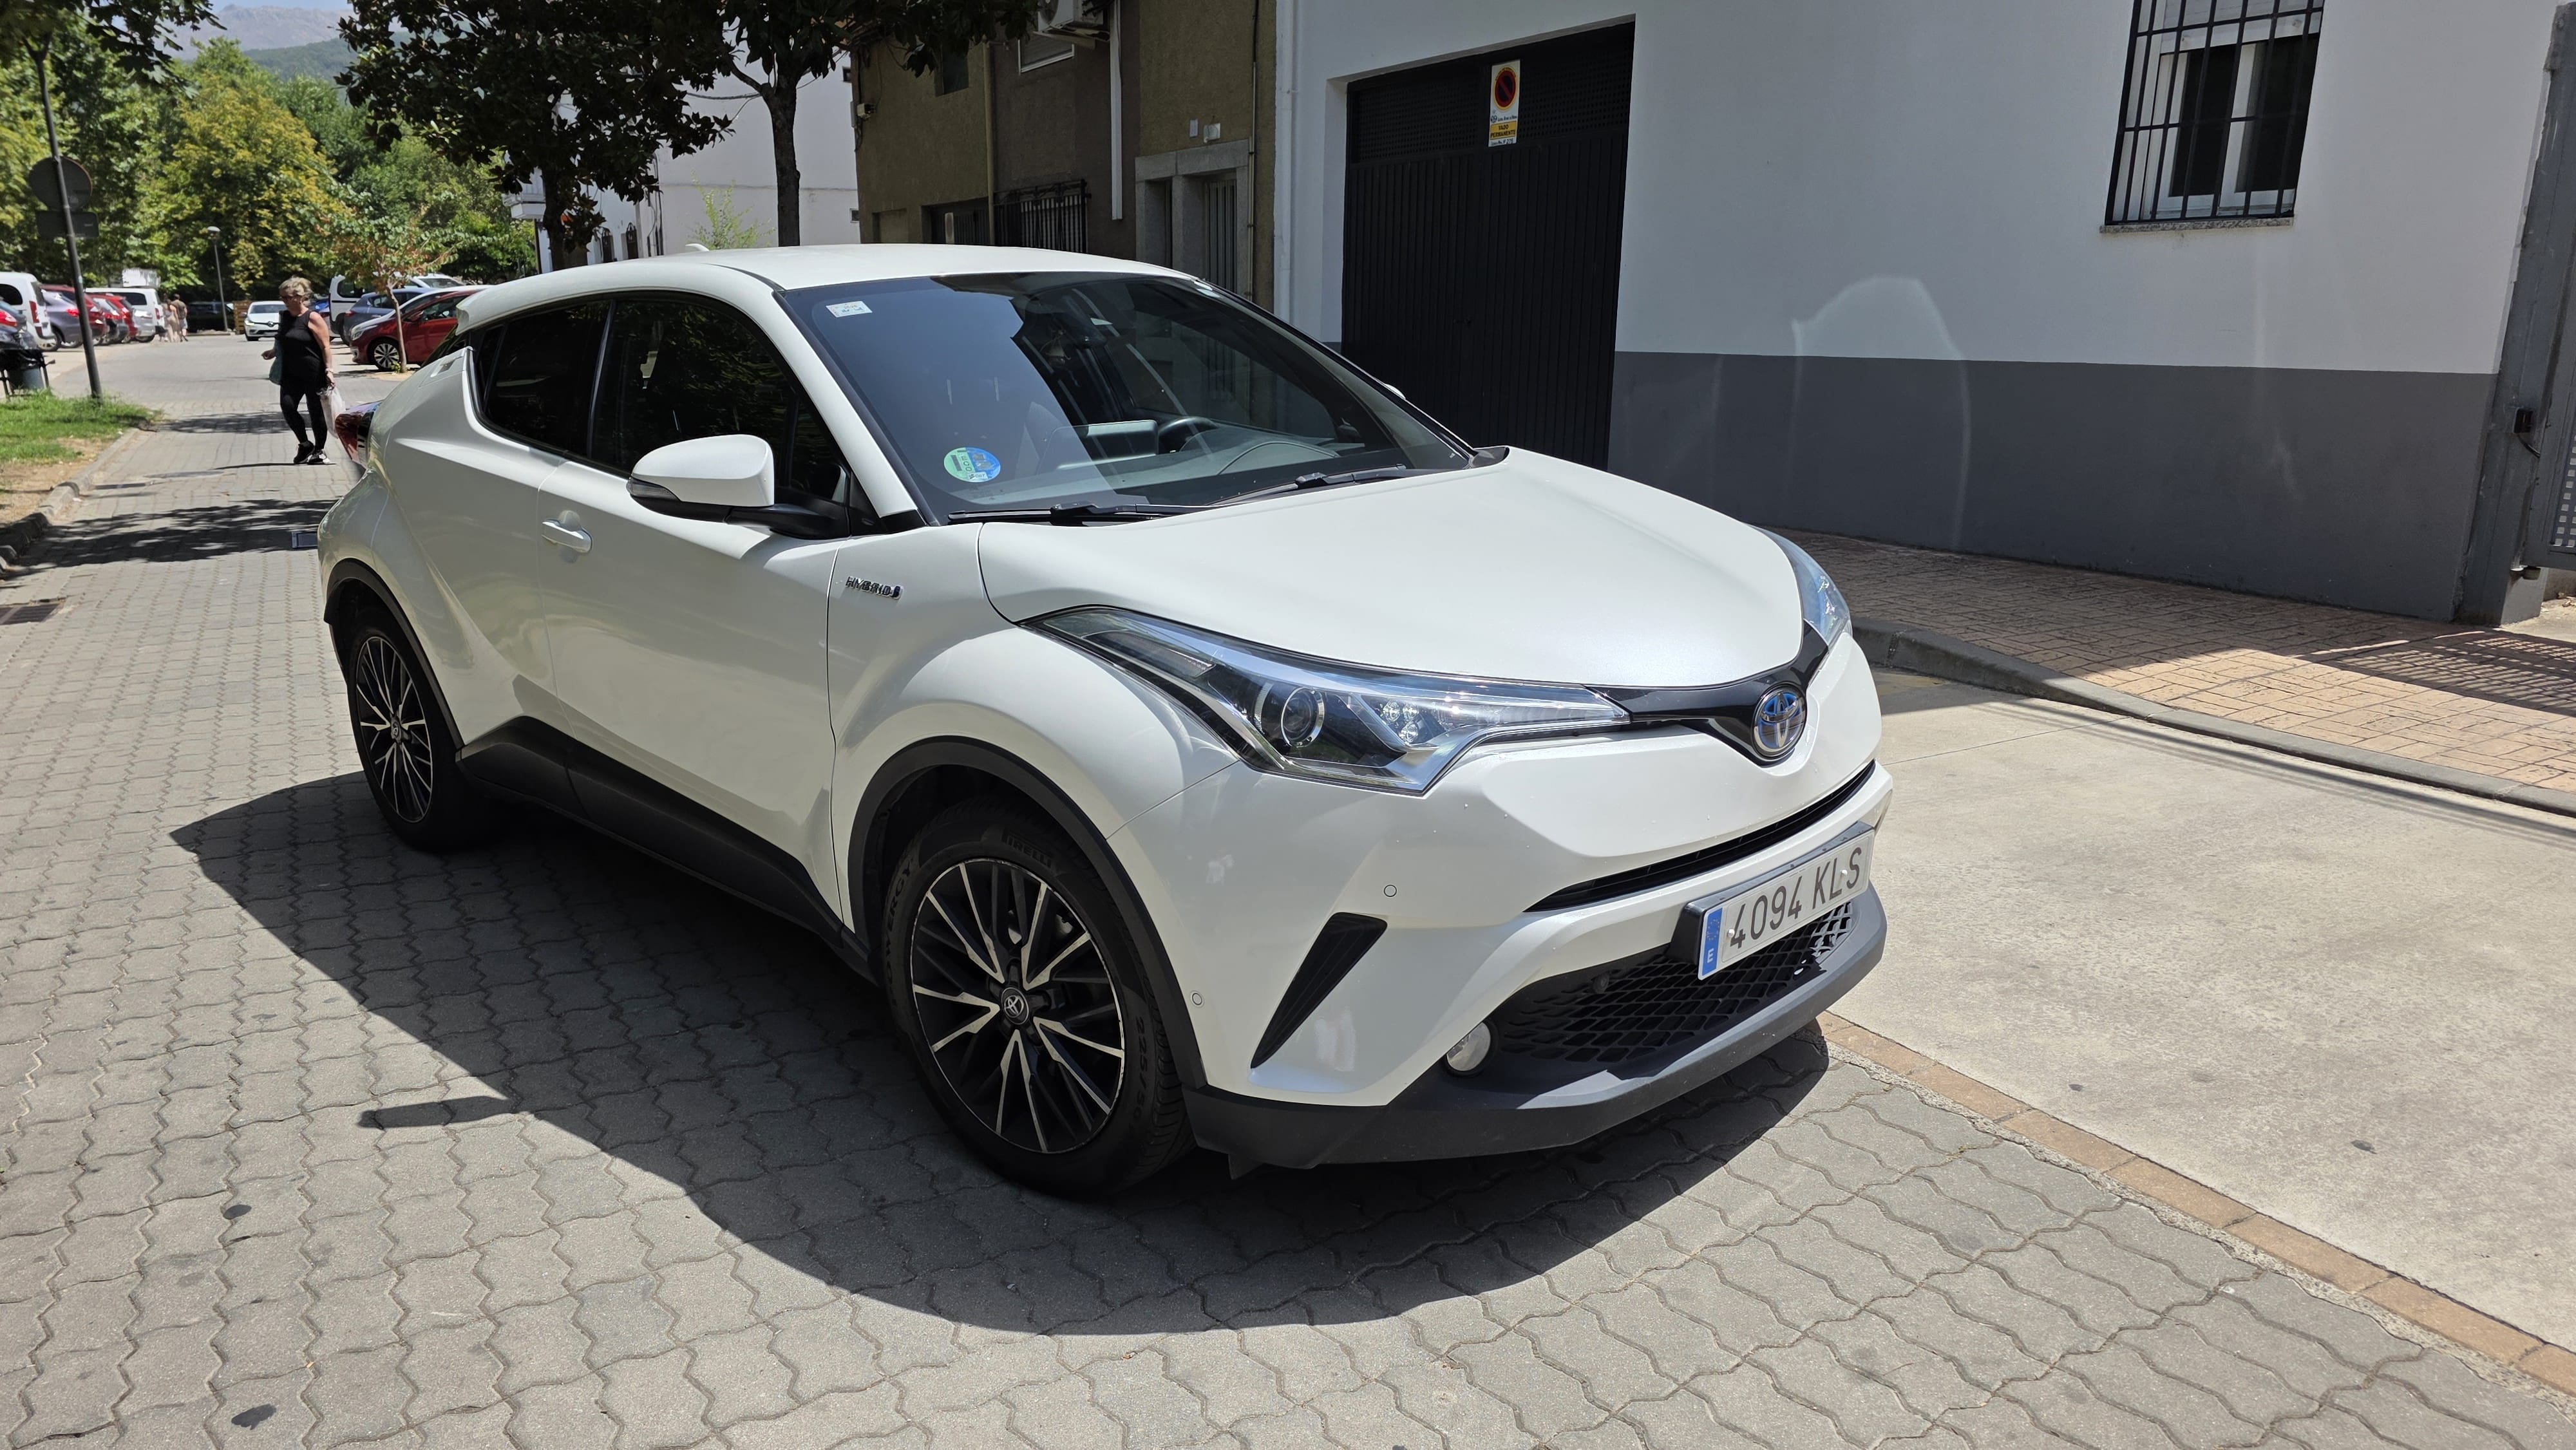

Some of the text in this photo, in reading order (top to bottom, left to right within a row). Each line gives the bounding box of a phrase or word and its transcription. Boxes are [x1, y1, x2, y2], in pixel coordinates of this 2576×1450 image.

[1491, 129, 1516, 138] PERMANENTE
[961, 455, 972, 472] ECO
[846, 576, 891, 597] HYBRID
[1001, 828, 1052, 868] PIRELLI
[1730, 847, 1862, 949] 4094 KLS
[1707, 948, 1714, 963] E
